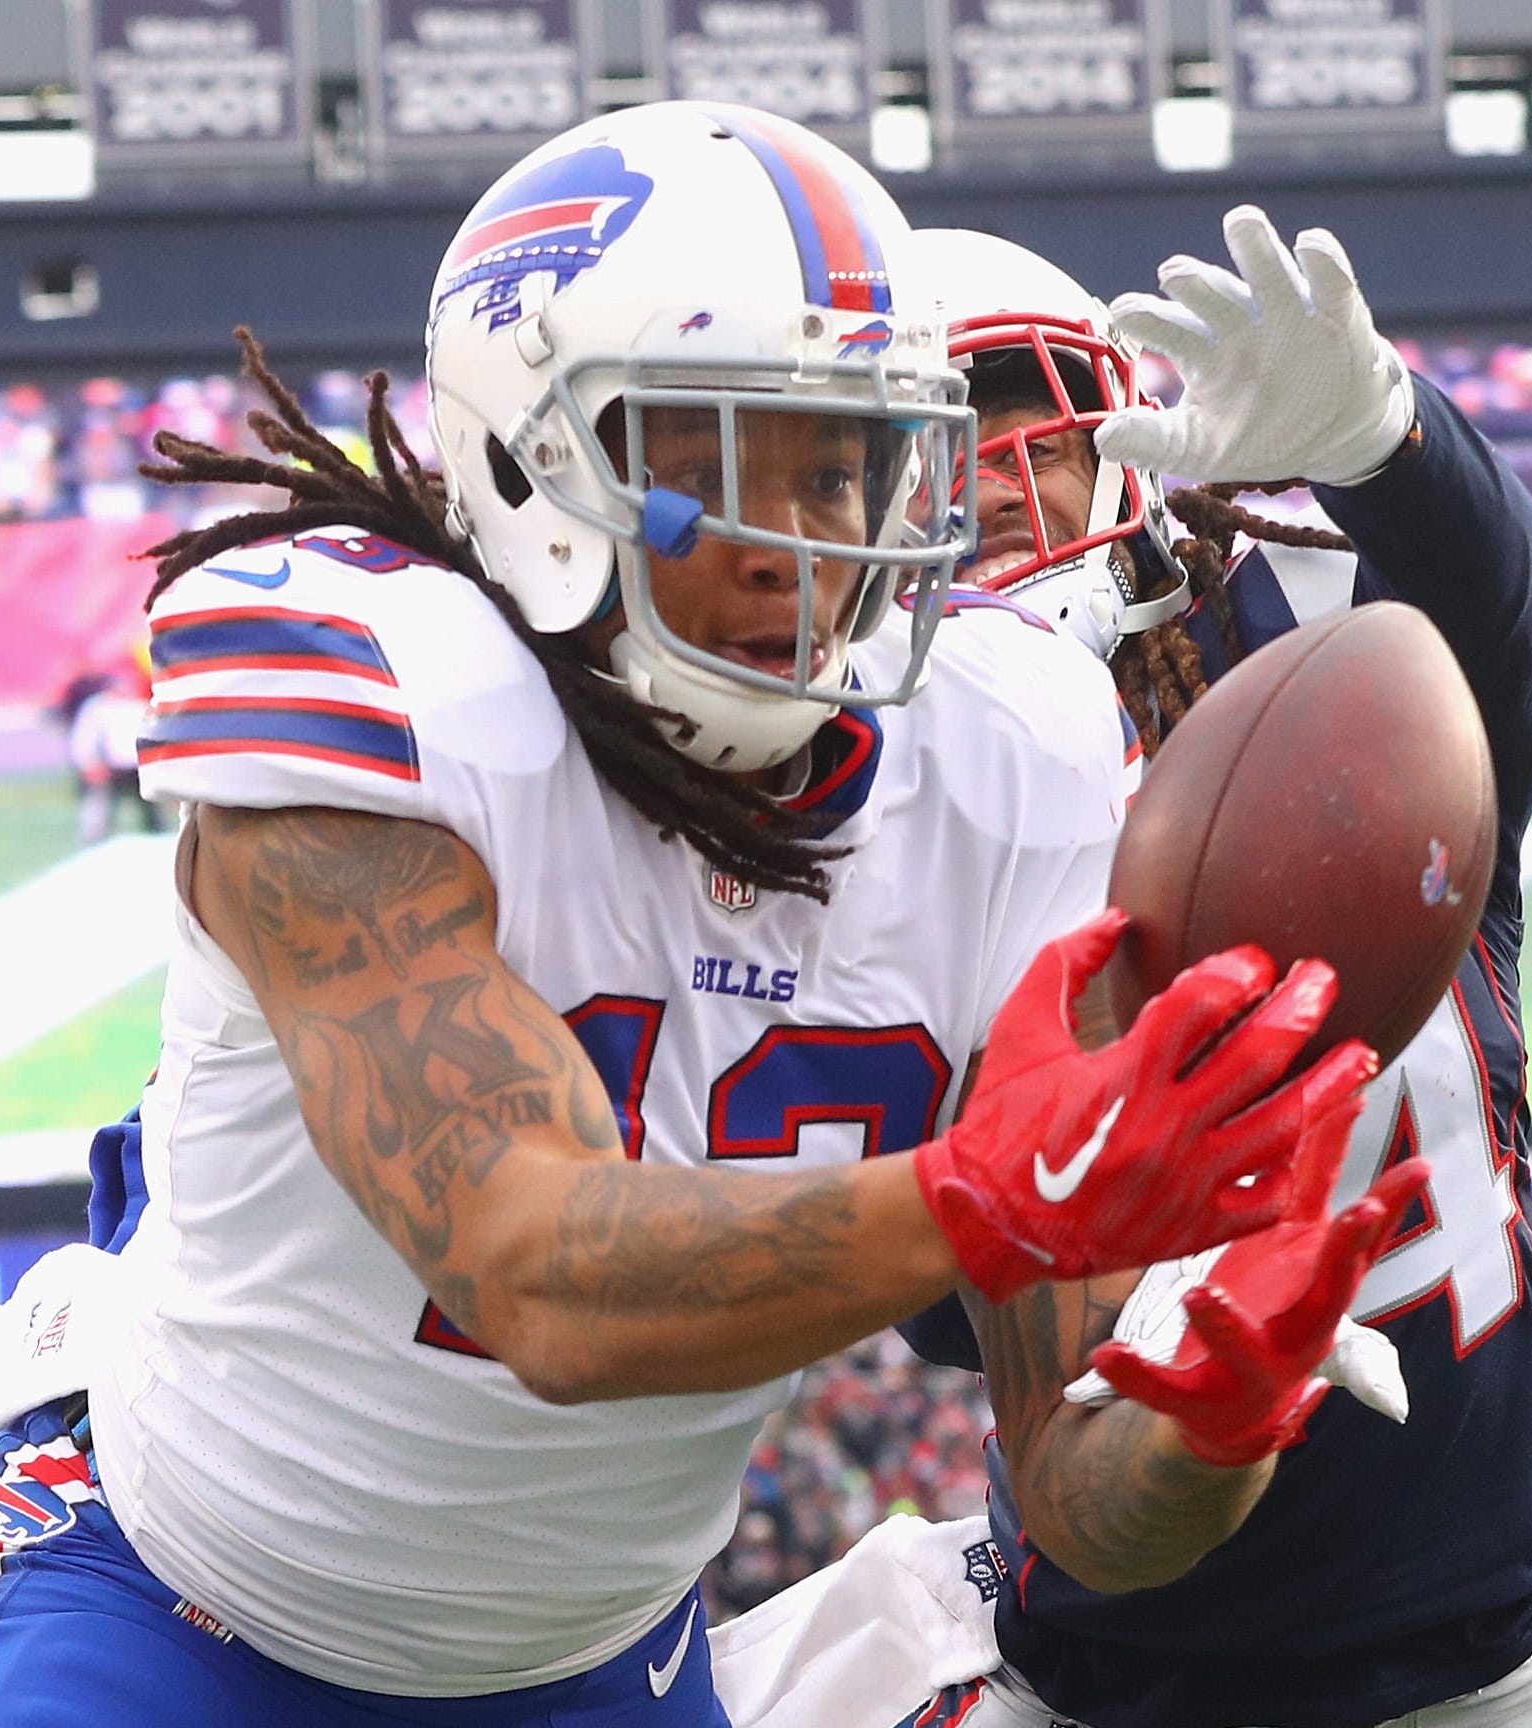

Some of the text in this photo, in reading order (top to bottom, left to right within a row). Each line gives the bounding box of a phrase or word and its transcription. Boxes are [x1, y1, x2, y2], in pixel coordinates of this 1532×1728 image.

[110, 84, 282, 140] 2001
[713, 873, 752, 905] NFL
[692, 956, 798, 1003] BILLS
